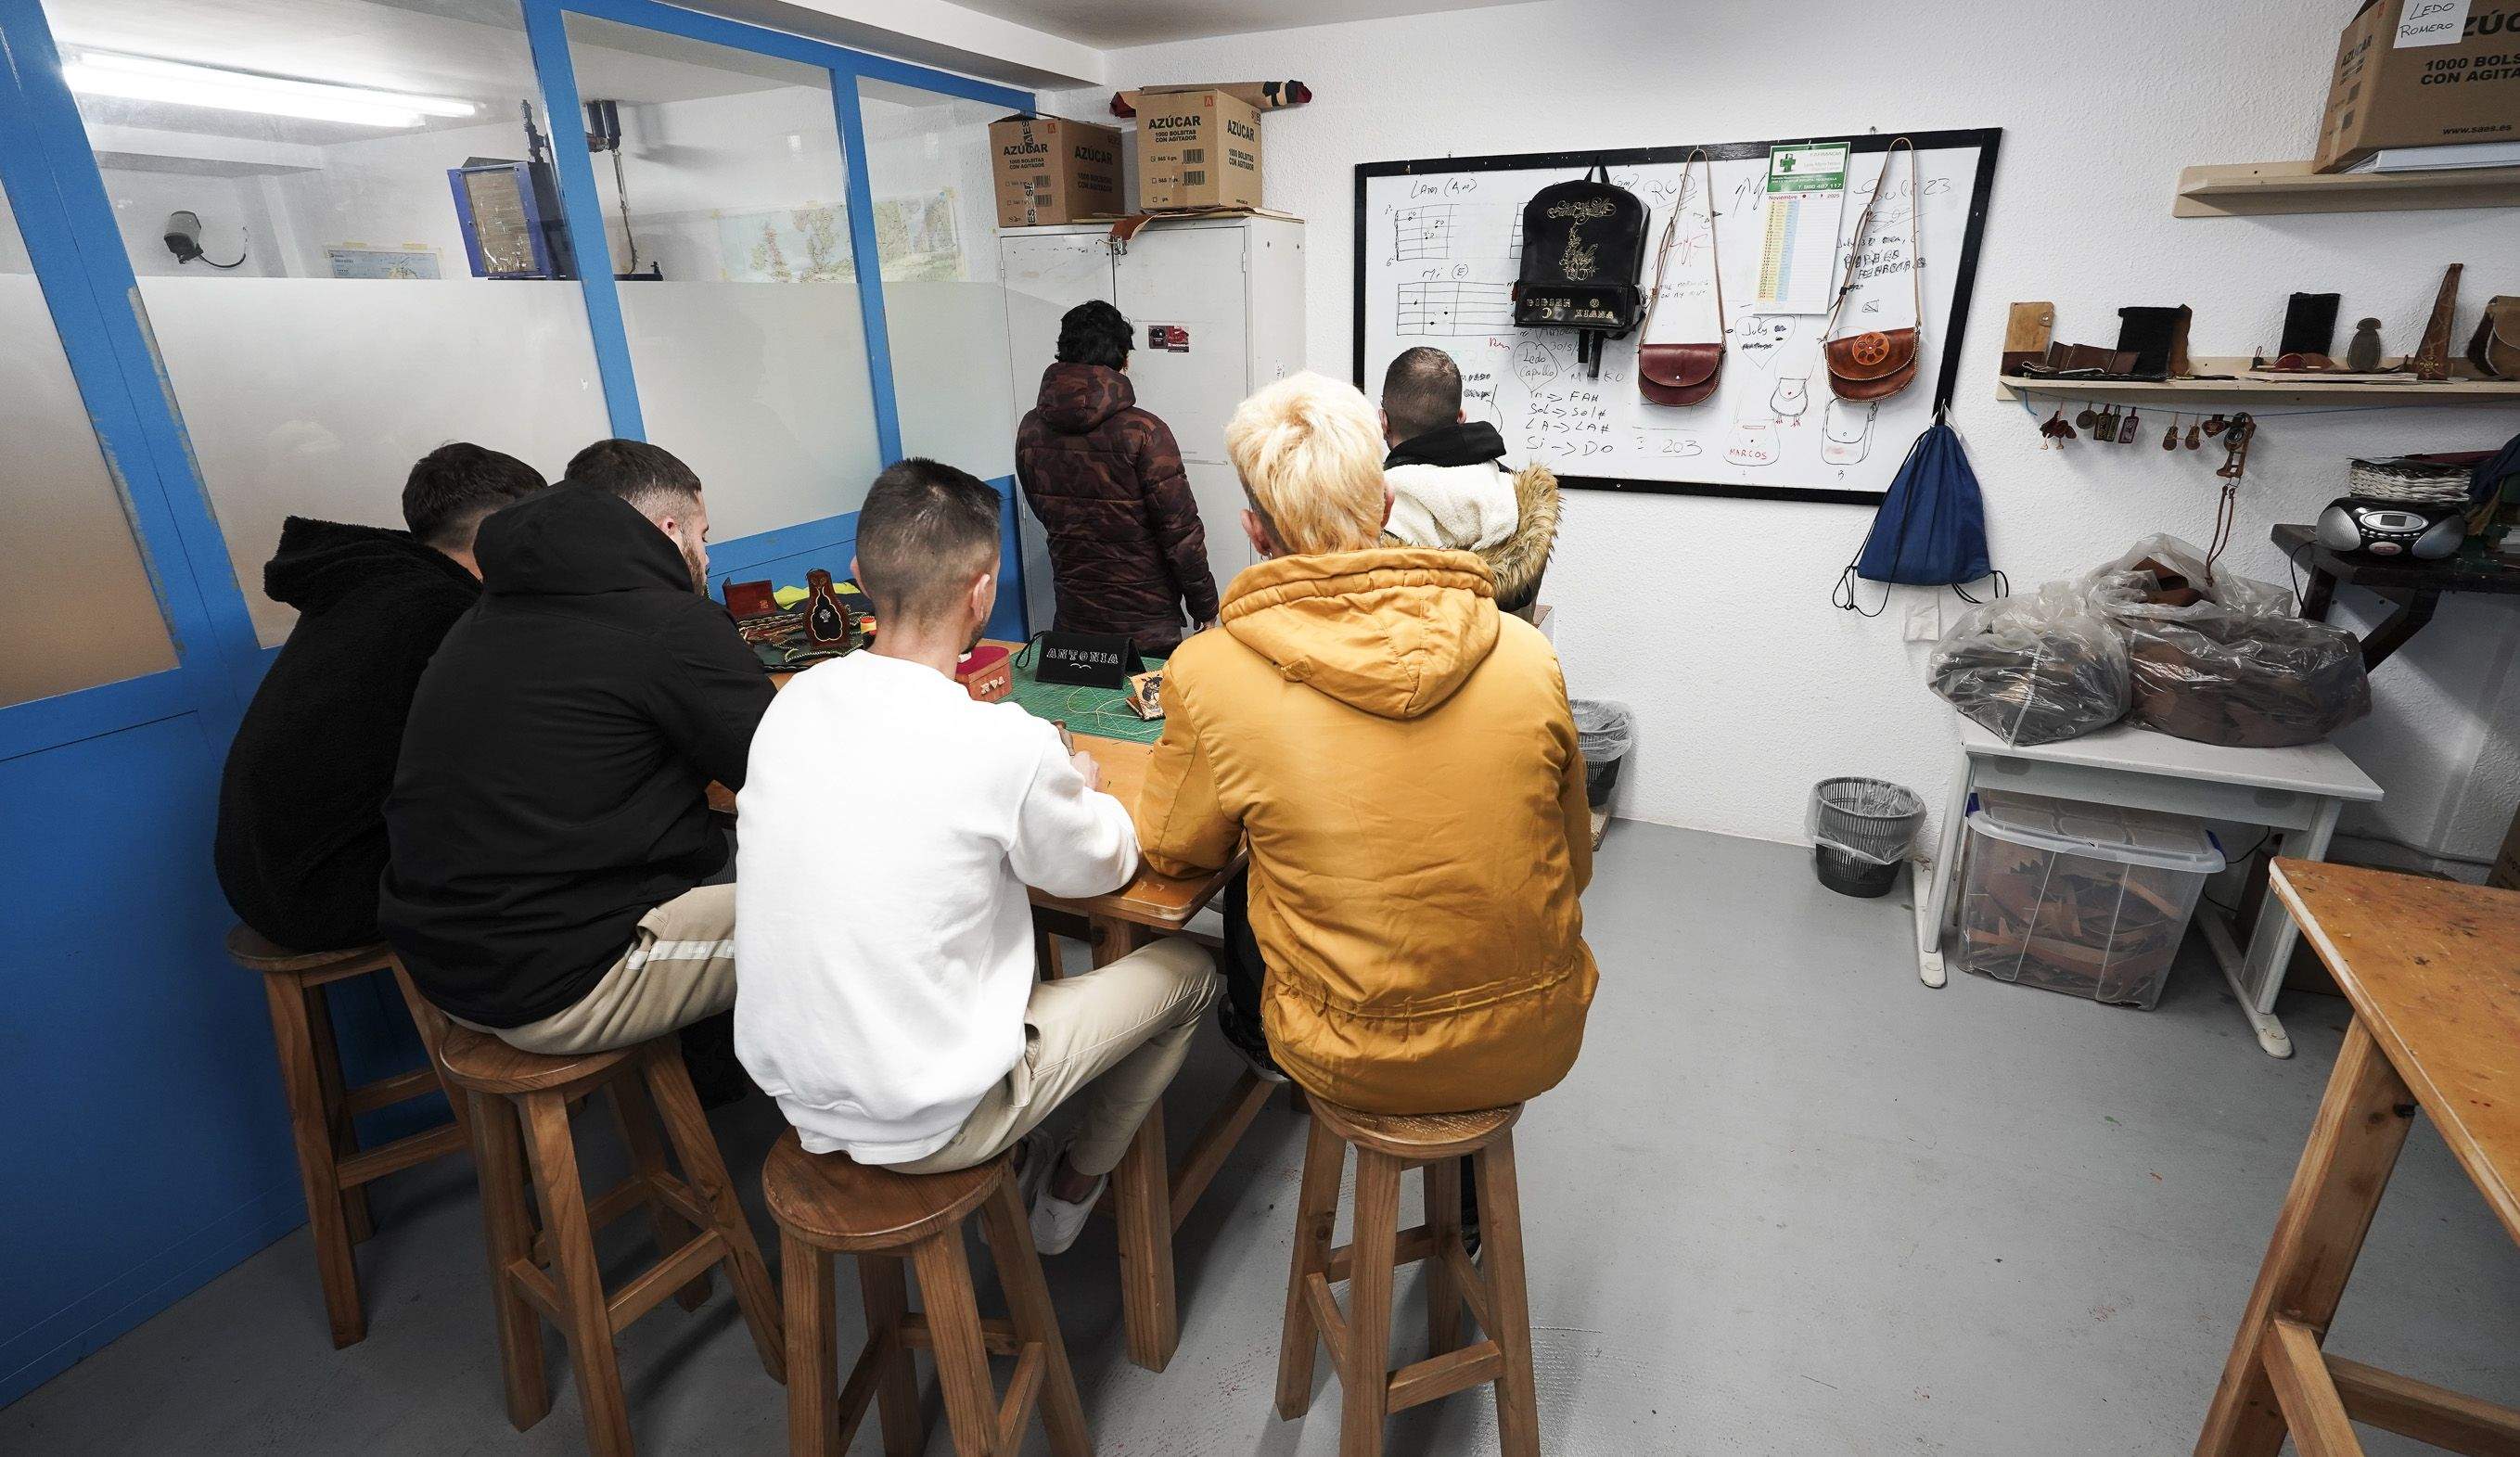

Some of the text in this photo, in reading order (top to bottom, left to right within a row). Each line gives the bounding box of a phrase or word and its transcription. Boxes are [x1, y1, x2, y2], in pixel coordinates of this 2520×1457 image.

[2410, 3, 2455, 20] LEDO
[2400, 22, 2454, 38] ROMERO
[2425, 60, 2468, 71] 1000
[2421, 72, 2460, 85] CON
[1149, 115, 1201, 129] AZÚCAR
[1227, 119, 1255, 142] AZÚCAR
[1004, 144, 1048, 156] AZÚCAR
[1074, 145, 1113, 165] AZÚCAR
[1729, 448, 1768, 460] MARCOS
[1046, 647, 1119, 665] ANTONIA
